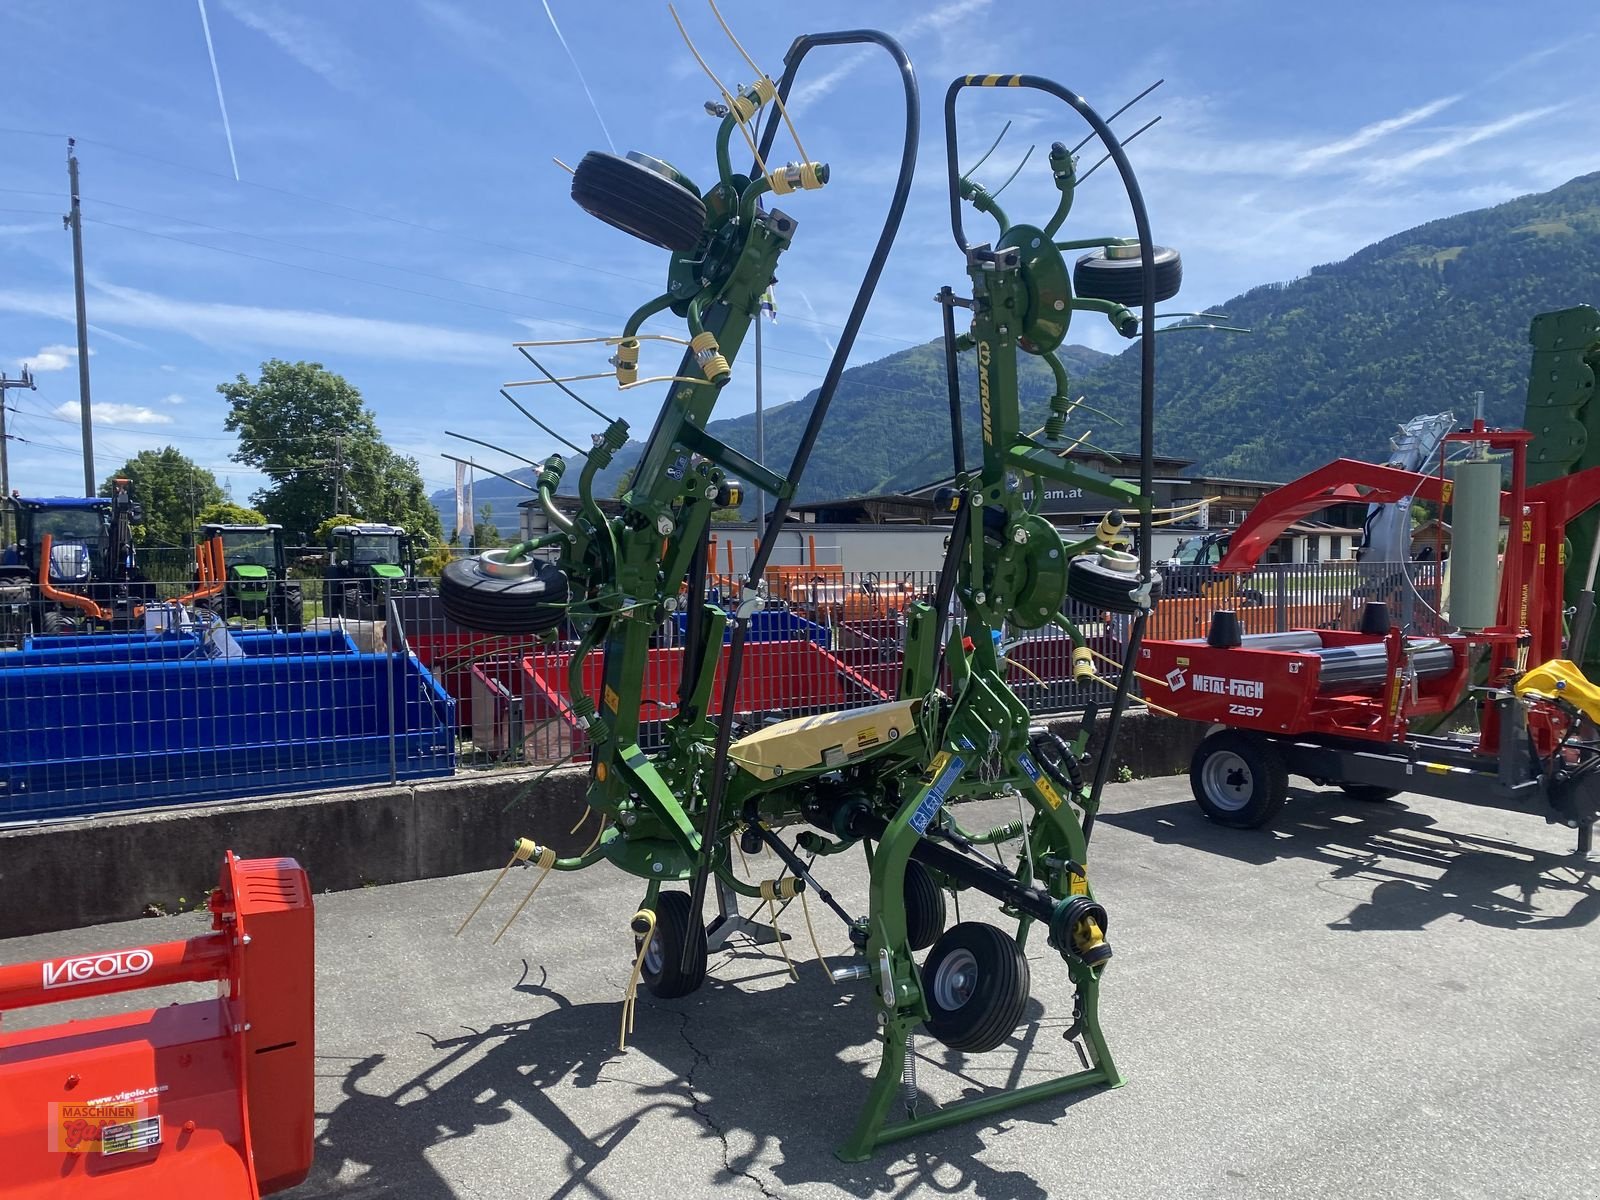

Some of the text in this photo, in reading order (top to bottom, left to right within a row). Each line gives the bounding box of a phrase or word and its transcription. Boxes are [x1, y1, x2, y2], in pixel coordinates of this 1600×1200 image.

[980, 366, 992, 446] KRONE
[1520, 584, 1529, 630] www.masch
[1229, 703, 1263, 717] Z237
[46, 952, 149, 986] VIGOLO
[87, 1085, 169, 1107] www.vigolo.com
